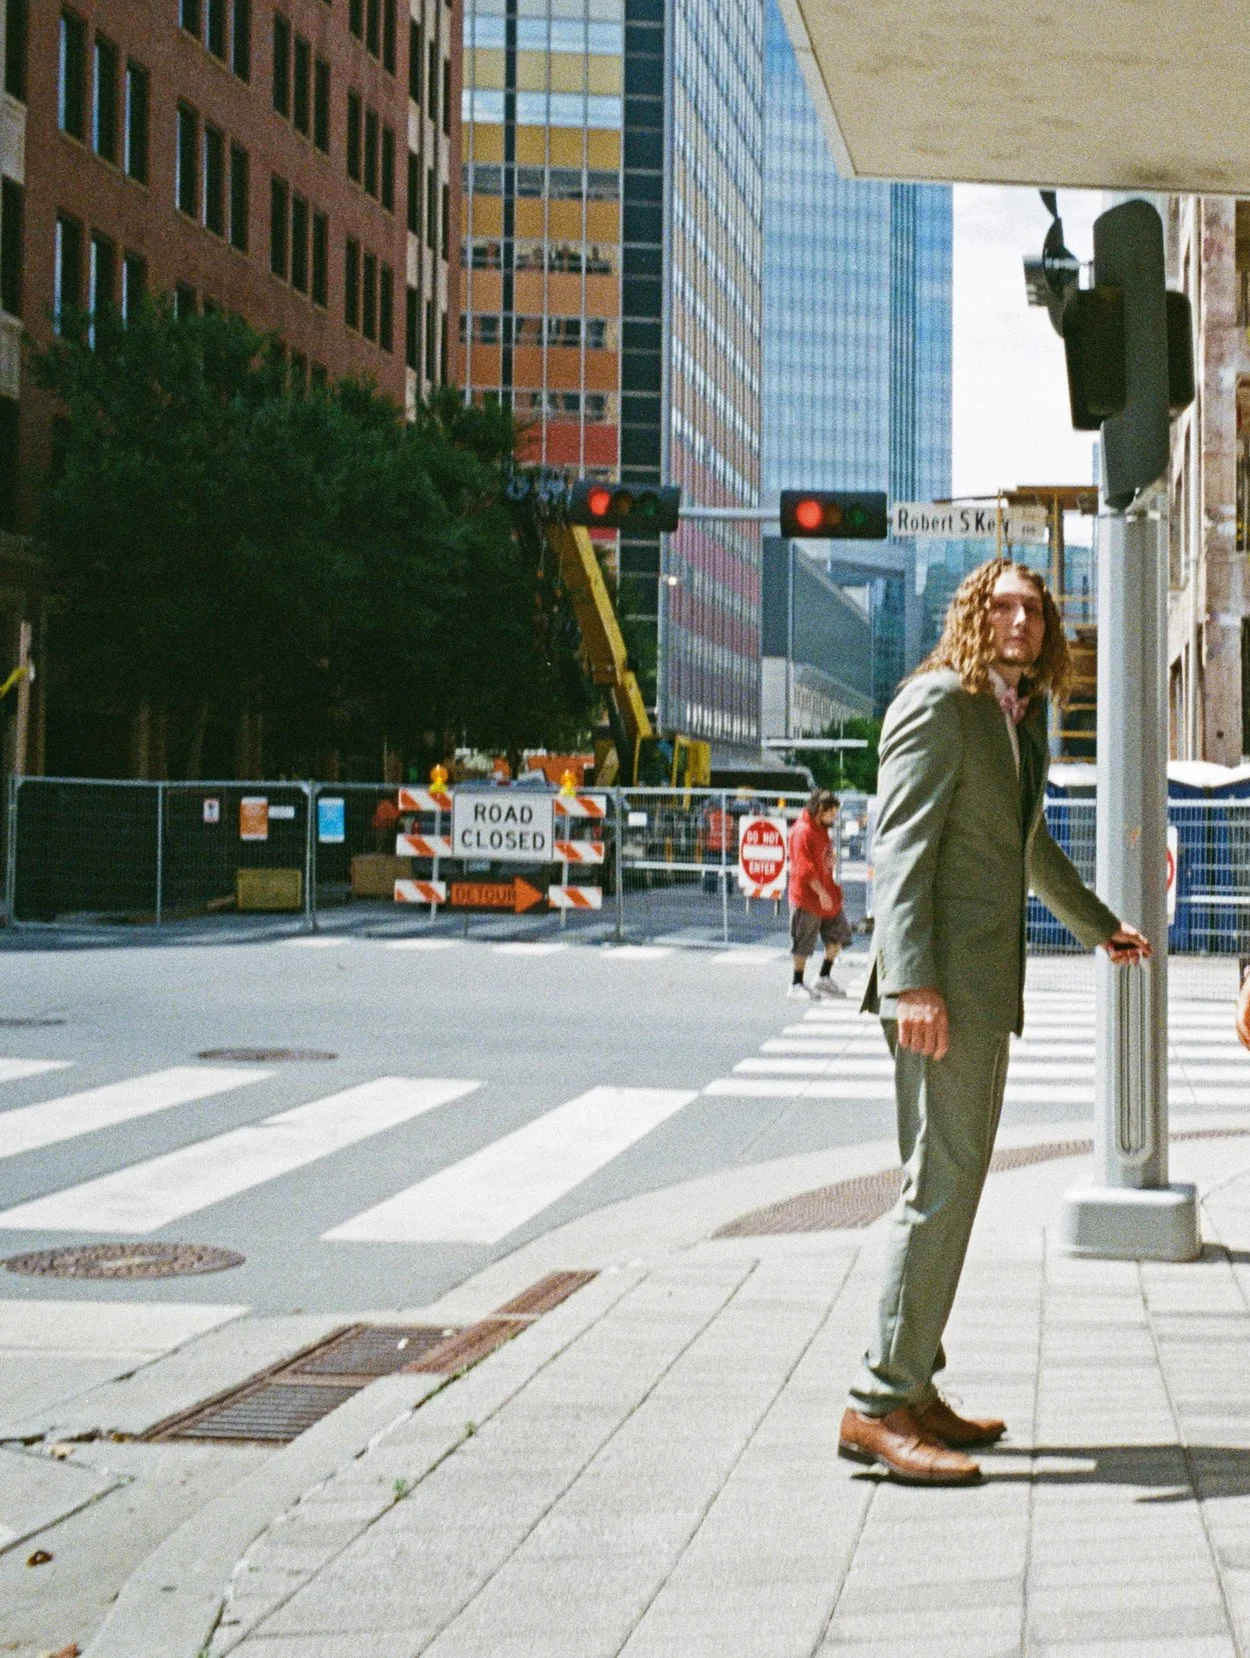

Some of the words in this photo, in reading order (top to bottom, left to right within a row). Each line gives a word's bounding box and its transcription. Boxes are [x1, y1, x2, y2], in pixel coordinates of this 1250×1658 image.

[898, 508, 953, 533] Robert
[960, 508, 970, 533] S
[473, 804, 533, 825] ROAD
[461, 830, 545, 851] CLOSED
[747, 831, 759, 843] DO
[763, 831, 779, 844] NOT
[749, 862, 776, 875] ENTER
[456, 884, 516, 901] DETOUR
